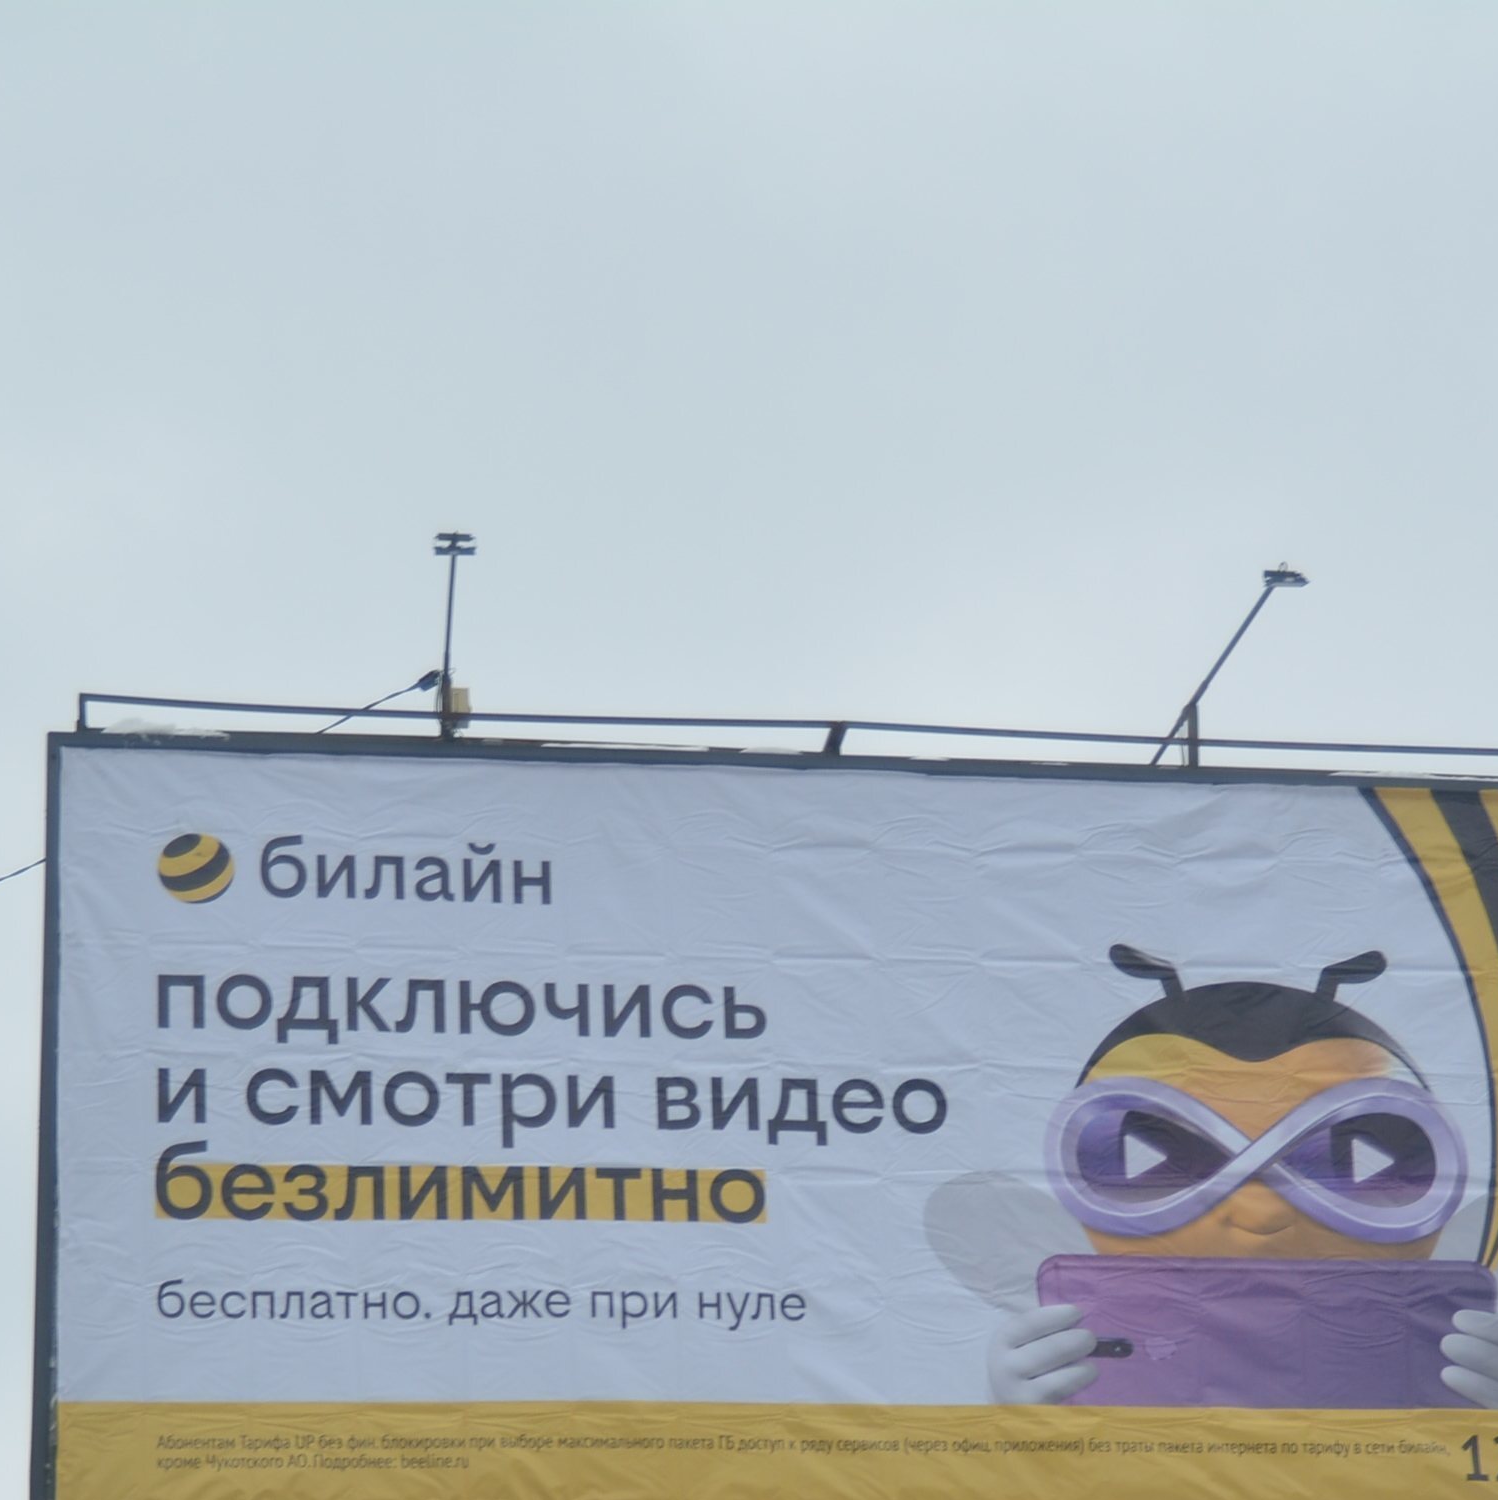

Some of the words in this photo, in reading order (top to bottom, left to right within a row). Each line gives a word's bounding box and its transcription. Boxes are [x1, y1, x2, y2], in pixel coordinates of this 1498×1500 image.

[259, 834, 553, 906] билайн
[157, 973, 768, 1044] подключись
[157, 1067, 206, 1124] и
[246, 1067, 615, 1148] смотри
[656, 1076, 948, 1146] видео
[156, 1140, 767, 1223] безлимитно
[448, 1289, 571, 1326] даже
[591, 1291, 678, 1328] при
[698, 1291, 807, 1331] нуле
[157, 1434, 235, 1449] Абонентам
[240, 1435, 291, 1451] Тарифа
[318, 1435, 342, 1449] без
[381, 1434, 466, 1451] блокировки
[470, 1438, 495, 1453] при
[500, 1434, 553, 1451] выборе
[557, 1436, 664, 1449] максимального
[668, 1437, 714, 1450] пакета
[737, 1437, 786, 1453] доступ
[836, 1439, 900, 1454] сервисов
[903, 1437, 948, 1455] (через
[995, 1437, 1084, 1456] приложения)
[1088, 1437, 1110, 1452] без
[1157, 1441, 1204, 1453] пакета
[1207, 1441, 1277, 1455] интернета
[1281, 1443, 1298, 1454] по
[1301, 1442, 1350, 1459] тарифу
[1365, 1443, 1394, 1455] сети
[157, 1457, 201, 1471] кроме
[205, 1454, 284, 1471] Чукотского
[400, 1454, 469, 1470] beeline.ru
